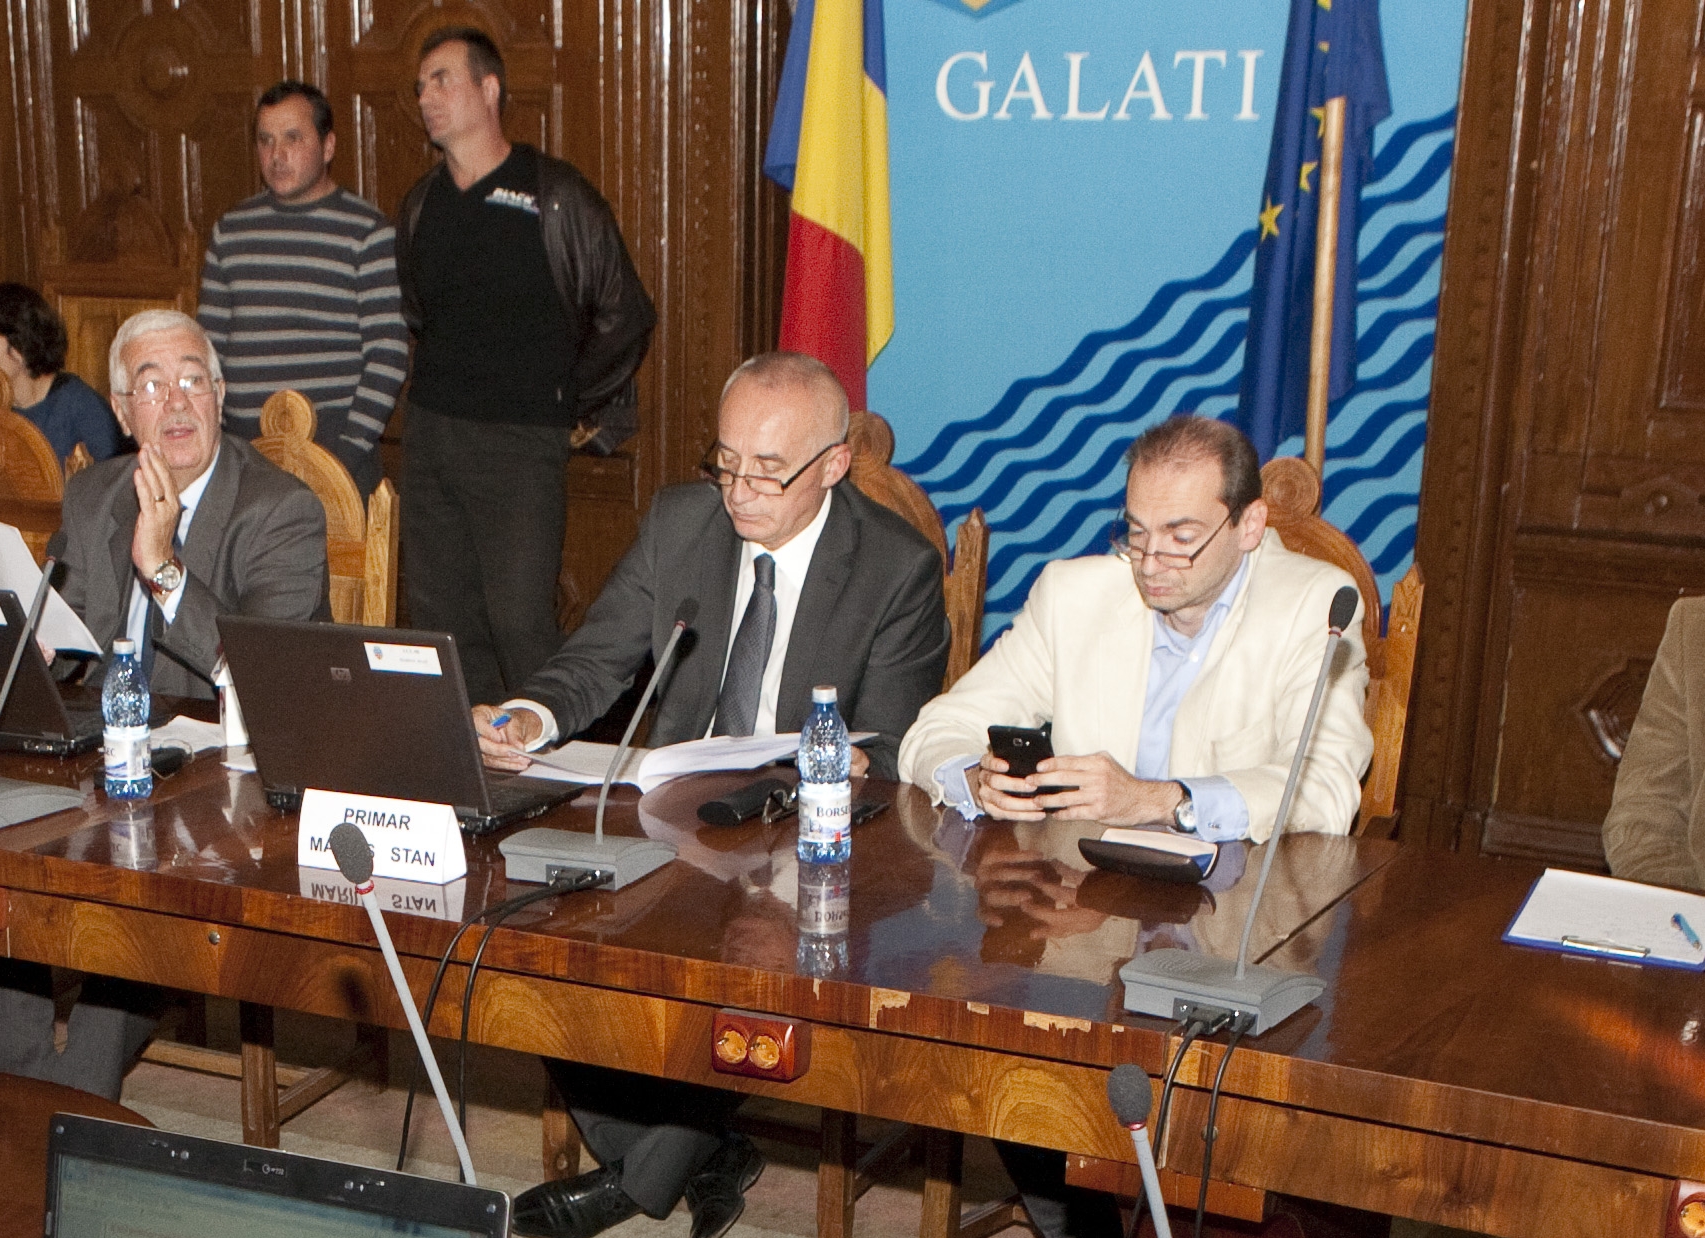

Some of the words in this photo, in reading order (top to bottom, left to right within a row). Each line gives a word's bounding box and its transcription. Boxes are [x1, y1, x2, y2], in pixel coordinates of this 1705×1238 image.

[934, 48, 1265, 122] GALATI
[344, 807, 411, 831] PRIMAR
[310, 836, 375, 859] MAS
[390, 846, 436, 867] STAN
